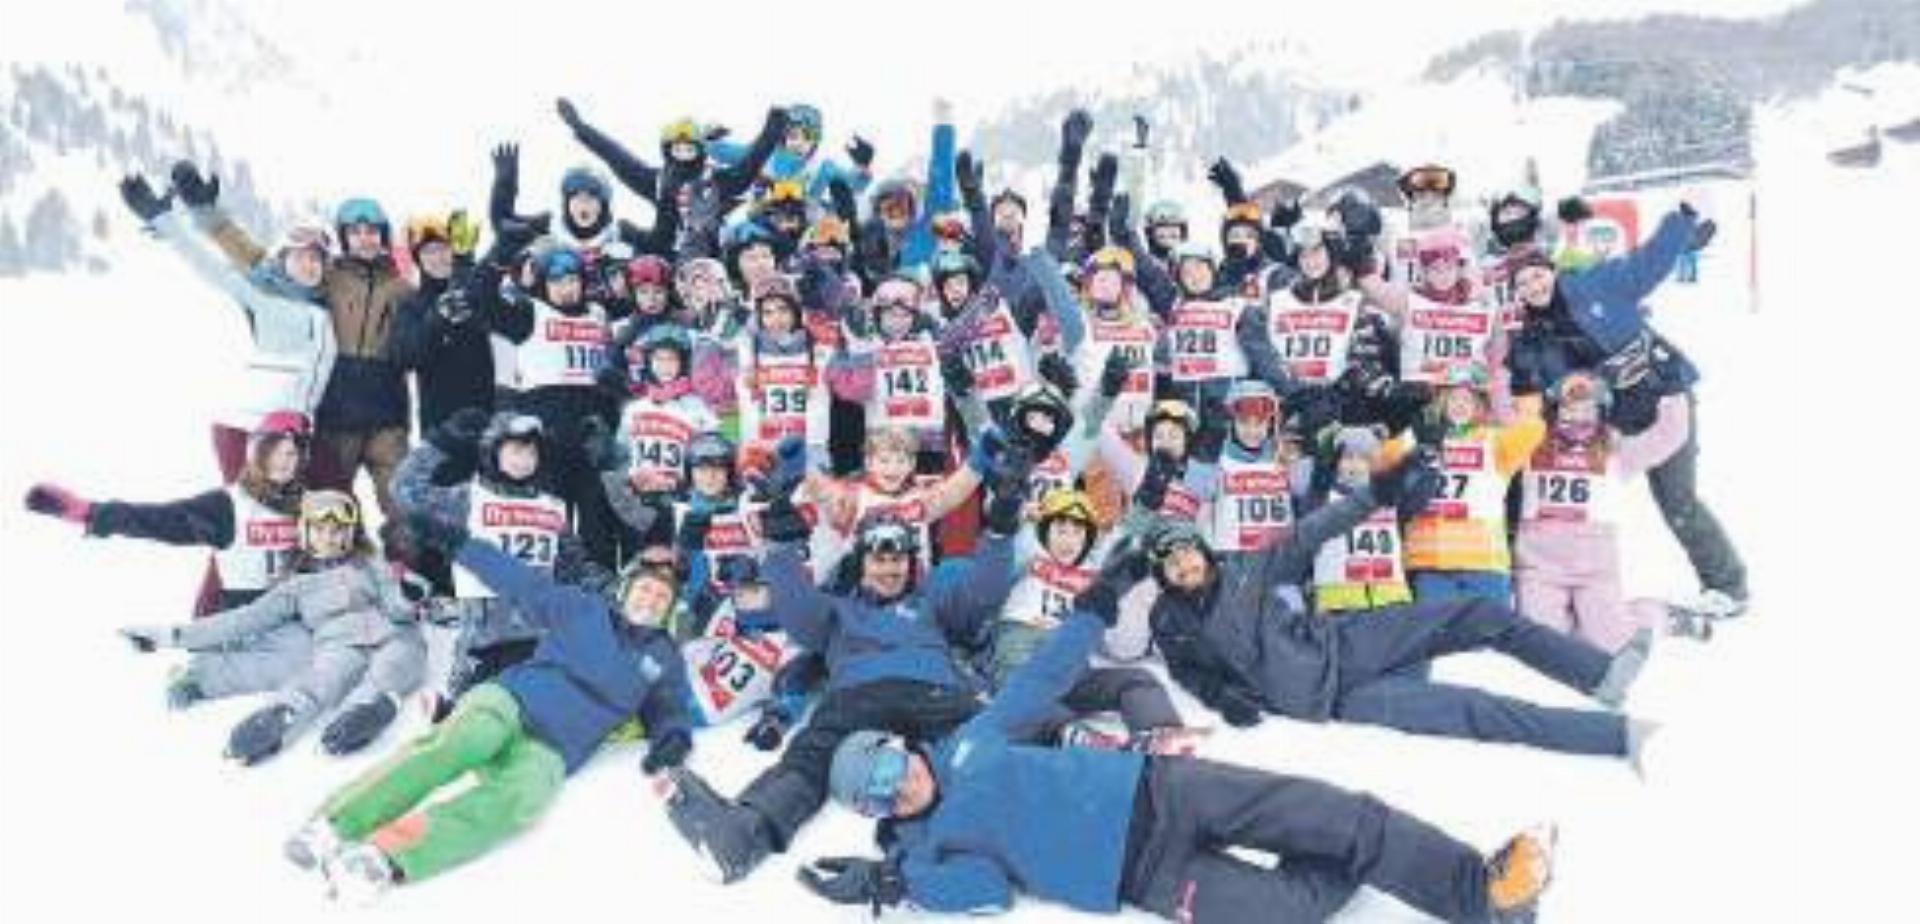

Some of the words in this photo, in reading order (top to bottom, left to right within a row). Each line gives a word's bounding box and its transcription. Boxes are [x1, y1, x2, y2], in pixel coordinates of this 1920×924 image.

[1423, 334, 1472, 357] 105
[885, 367, 929, 396] 142
[637, 440, 681, 467] 143
[1537, 474, 1590, 503] 126
[1238, 495, 1286, 522] 106
[500, 533, 551, 562] 123
